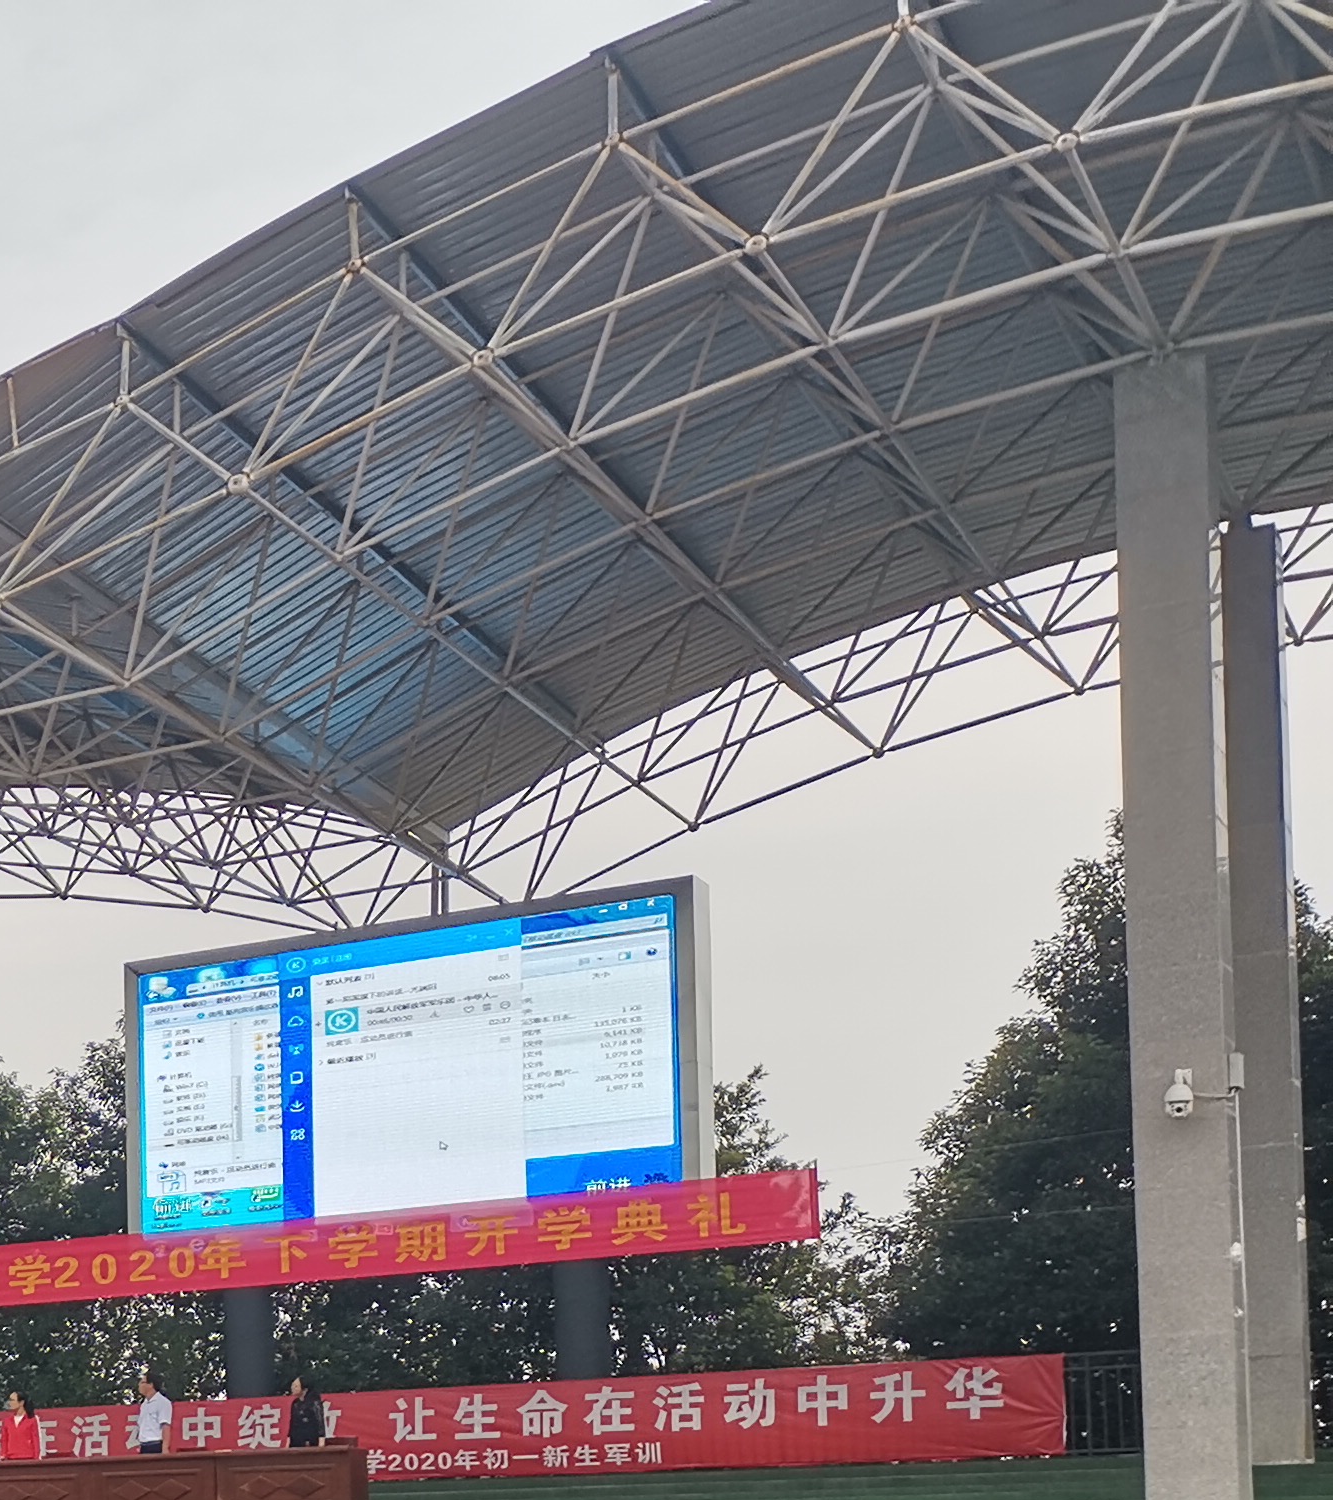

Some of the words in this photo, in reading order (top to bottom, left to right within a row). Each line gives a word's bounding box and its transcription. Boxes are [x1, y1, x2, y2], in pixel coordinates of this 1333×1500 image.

[389, 1366, 1004, 1444] 让生命在活动中升华
[366, 1440, 663, 1475] 学2020年初一新生军训
